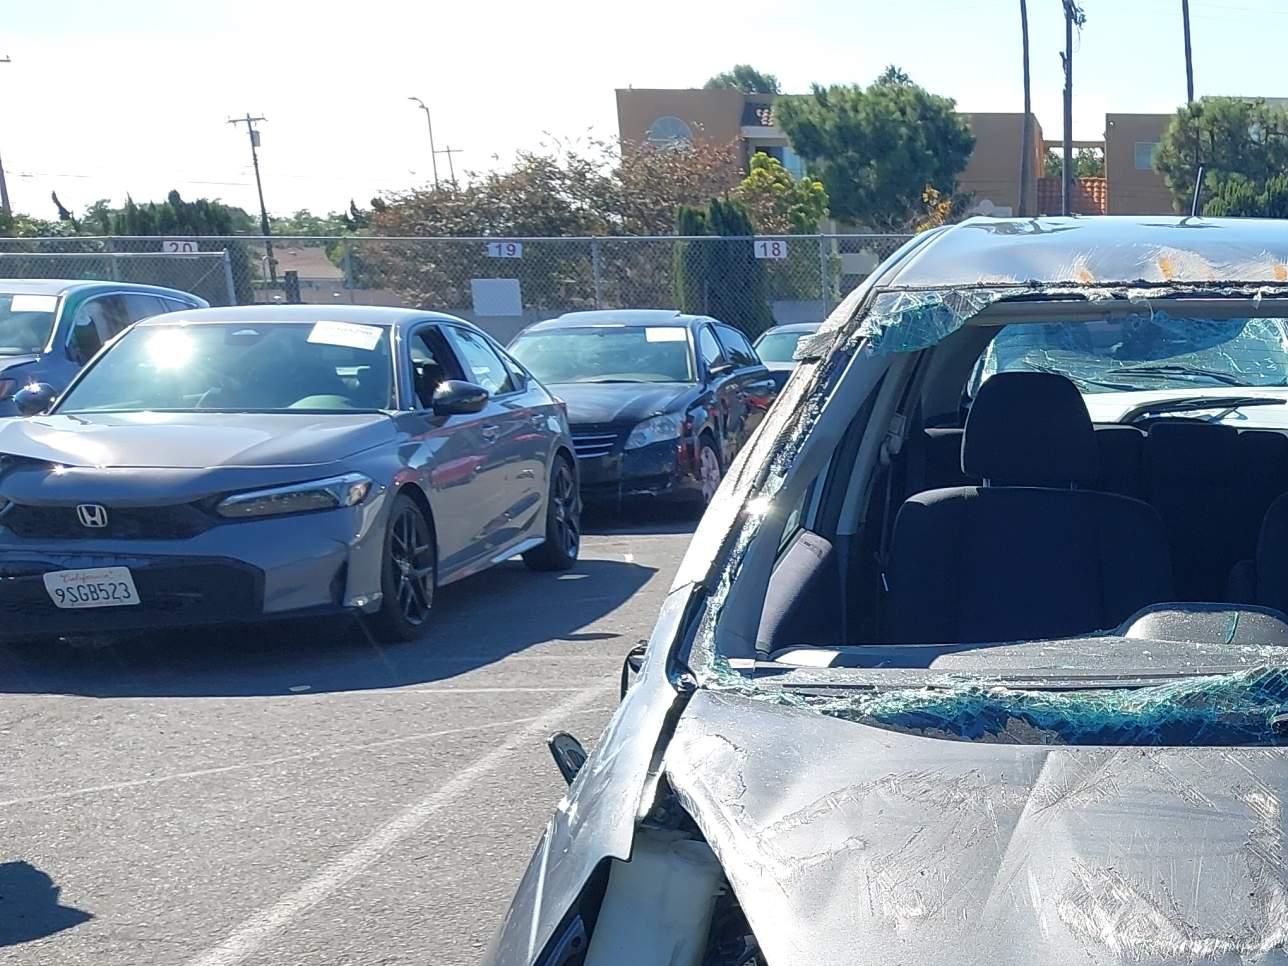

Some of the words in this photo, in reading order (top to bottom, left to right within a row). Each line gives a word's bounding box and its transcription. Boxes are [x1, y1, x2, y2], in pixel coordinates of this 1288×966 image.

[496, 244, 516, 256] 19
[760, 242, 781, 256] 18
[55, 582, 132, 603] 9SGB523
